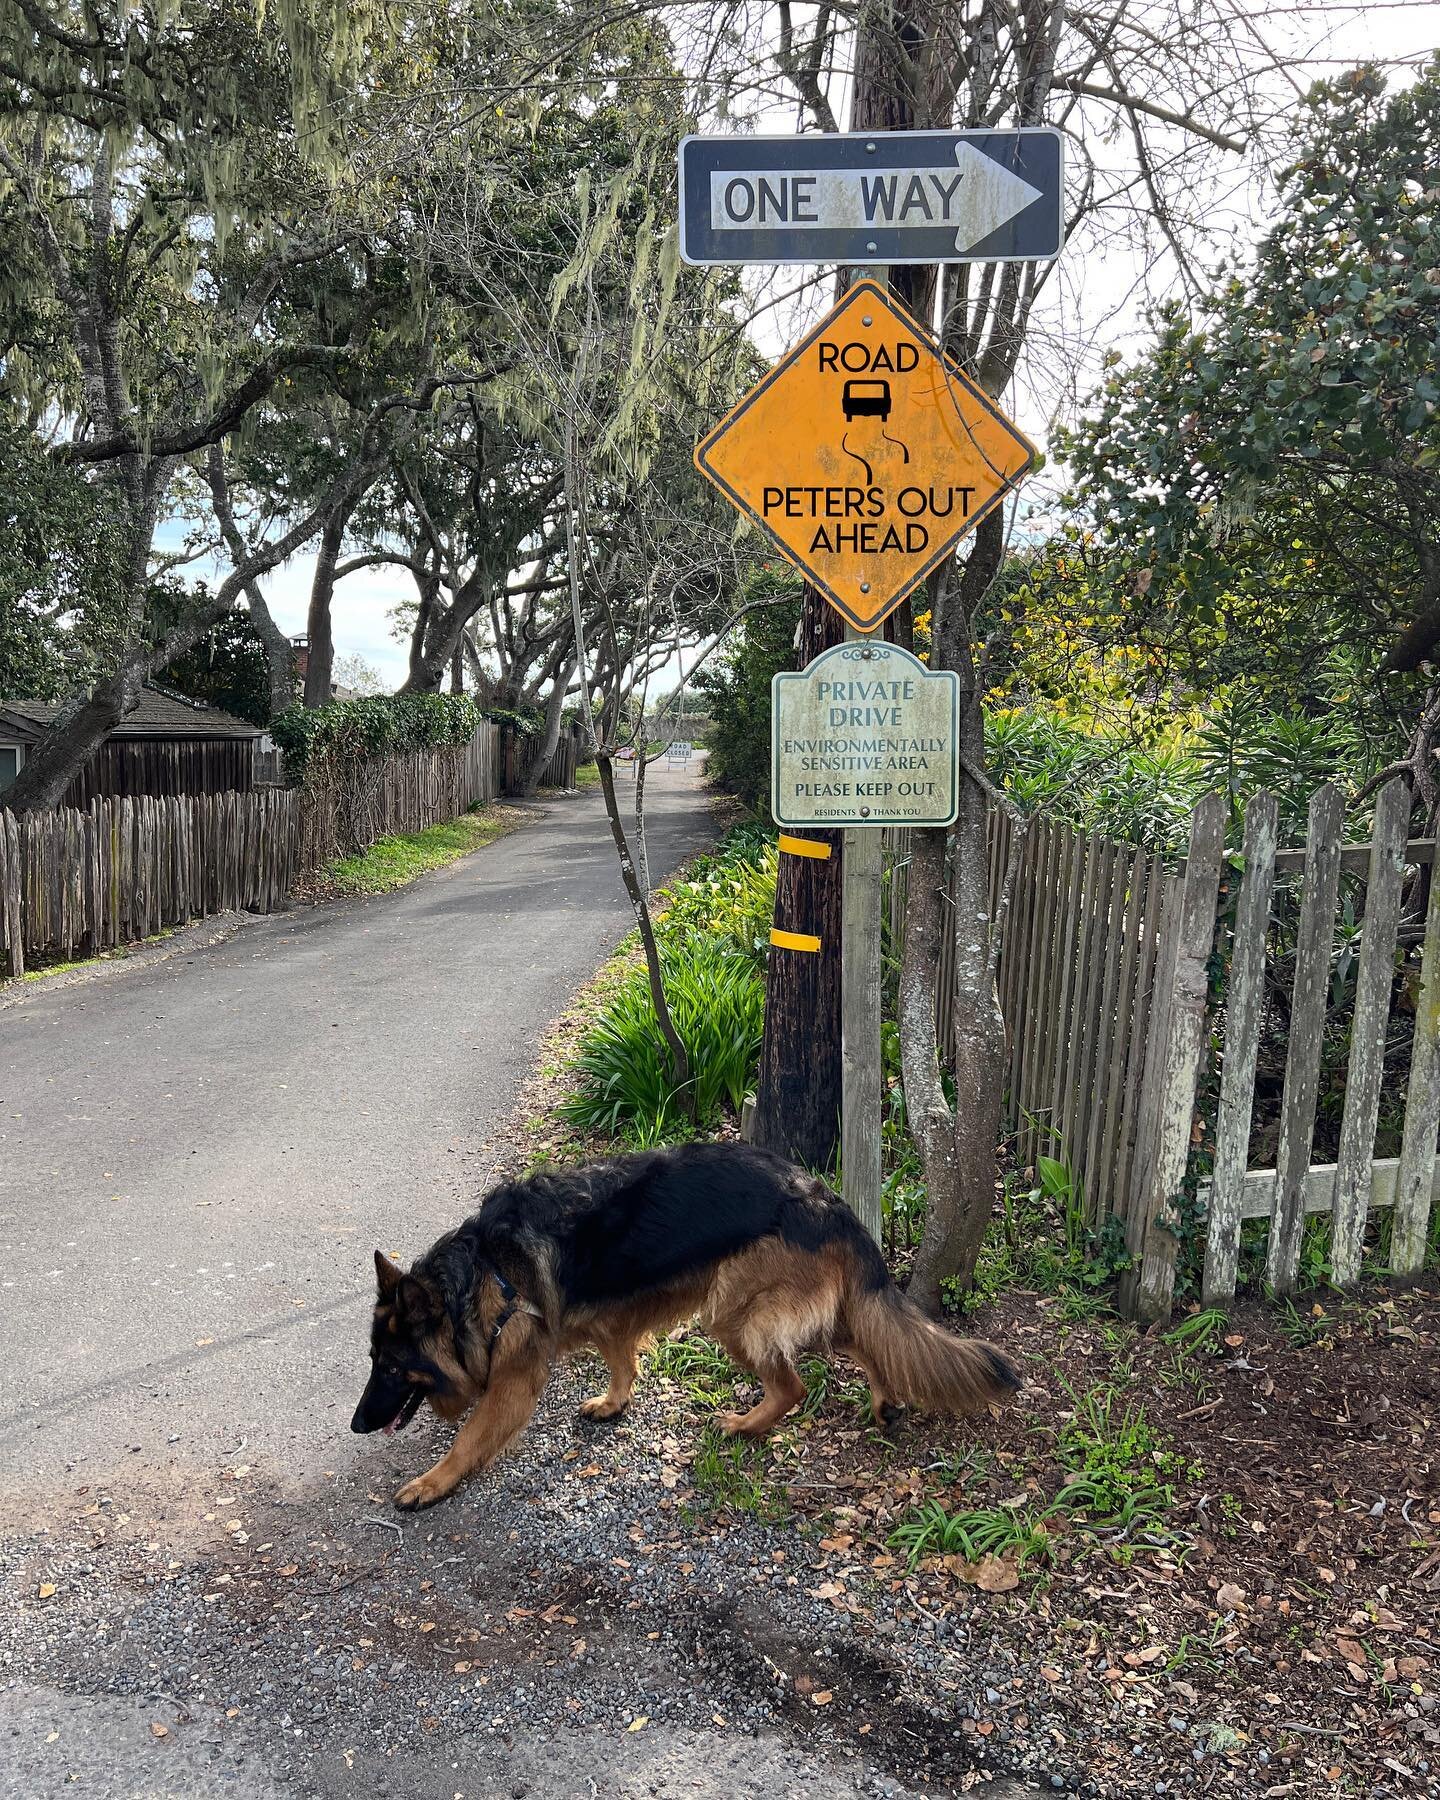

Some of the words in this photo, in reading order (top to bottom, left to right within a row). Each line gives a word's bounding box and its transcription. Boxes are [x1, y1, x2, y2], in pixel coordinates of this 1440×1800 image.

[725, 177, 818, 223] ONE
[860, 174, 964, 221] WAY
[818, 342, 920, 373] ROAD
[763, 487, 885, 518] PETERS
[897, 487, 976, 518] OUT
[808, 523, 929, 553] AHEAD
[818, 681, 914, 701] PRIVATE
[829, 707, 902, 727] DRIVE
[784, 738, 947, 753] ENVIRONMENTALLY
[801, 756, 882, 771] SENSITIVE
[886, 756, 929, 770] AREA
[795, 783, 850, 797] PLEASE
[856, 782, 893, 796] KEEP
[898, 782, 935, 796] OUT
[814, 808, 856, 816] RESIDENTS
[873, 808, 901, 816] THANK
[903, 808, 921, 816] YOU
